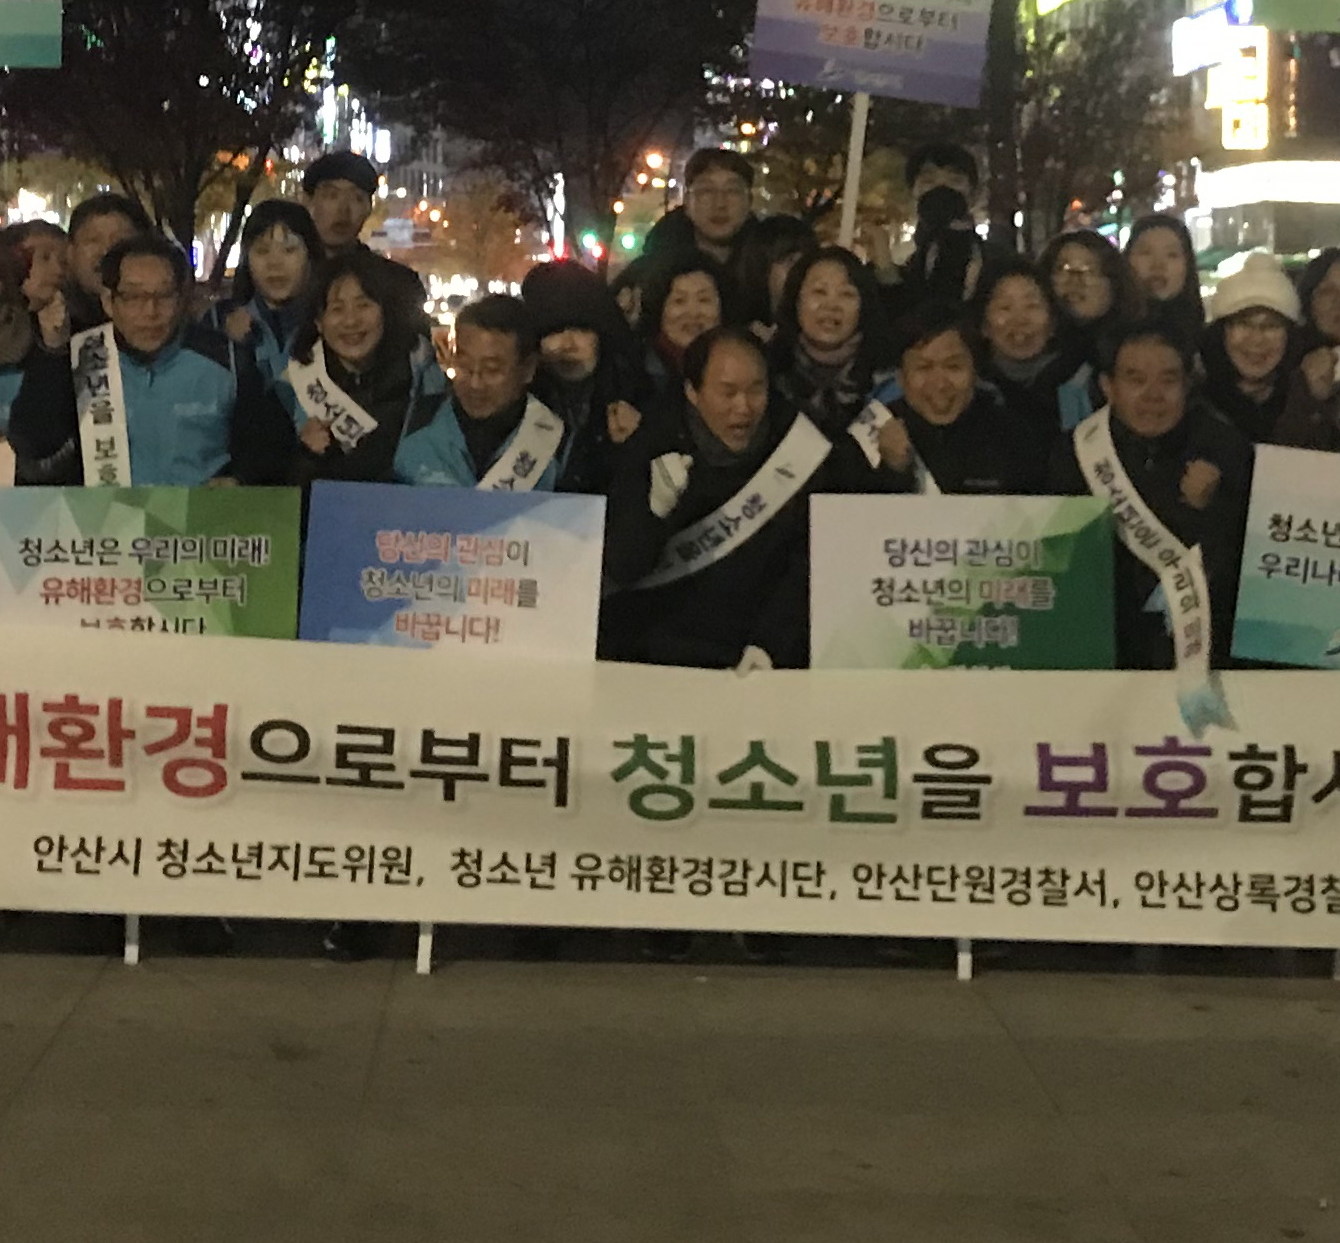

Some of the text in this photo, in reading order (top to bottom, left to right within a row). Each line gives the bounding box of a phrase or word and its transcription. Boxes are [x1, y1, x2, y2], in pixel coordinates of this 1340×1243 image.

[17, 536, 271, 567] 청소년은 우리의 미래!
[375, 530, 530, 567] 당신의 관심이
[882, 537, 1042, 568] 당신의 관심이
[39, 575, 248, 606] 유해환경으로부터
[362, 567, 539, 608] 청소년의 미래를
[869, 575, 1055, 609] 청소년의 미래를
[394, 612, 501, 644] 바꿉니다!
[610, 733, 993, 825] 청소년을
[32, 835, 142, 878] 안산시
[155, 836, 425, 888] 청소년지도위원,
[449, 846, 558, 892] 청소년
[569, 852, 839, 903] 유해환경감시단,
[852, 861, 1121, 911] 안산단원경찰서,
